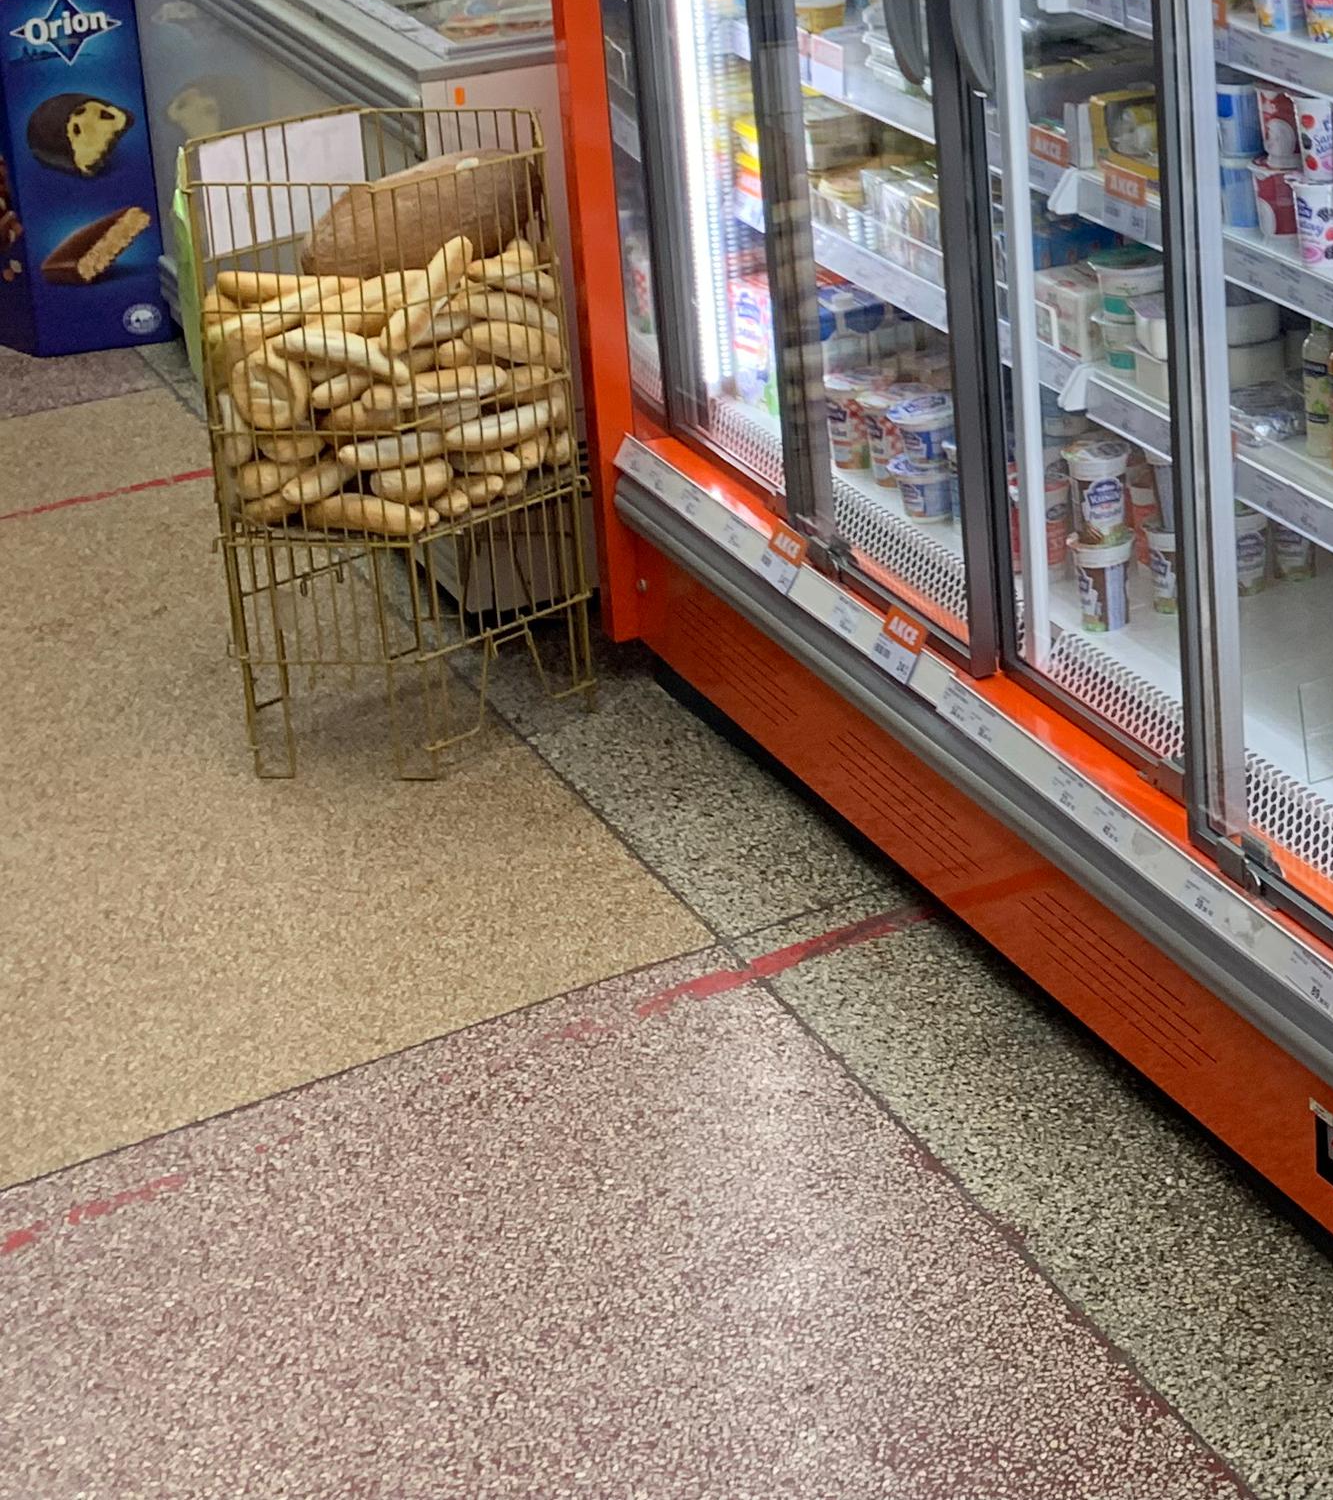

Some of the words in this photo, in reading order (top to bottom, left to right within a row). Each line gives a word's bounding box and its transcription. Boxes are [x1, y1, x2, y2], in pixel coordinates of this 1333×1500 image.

[23, 8, 109, 47] Orion
[1109, 174, 1140, 198] AKCE
[887, 615, 920, 648] AKCE
